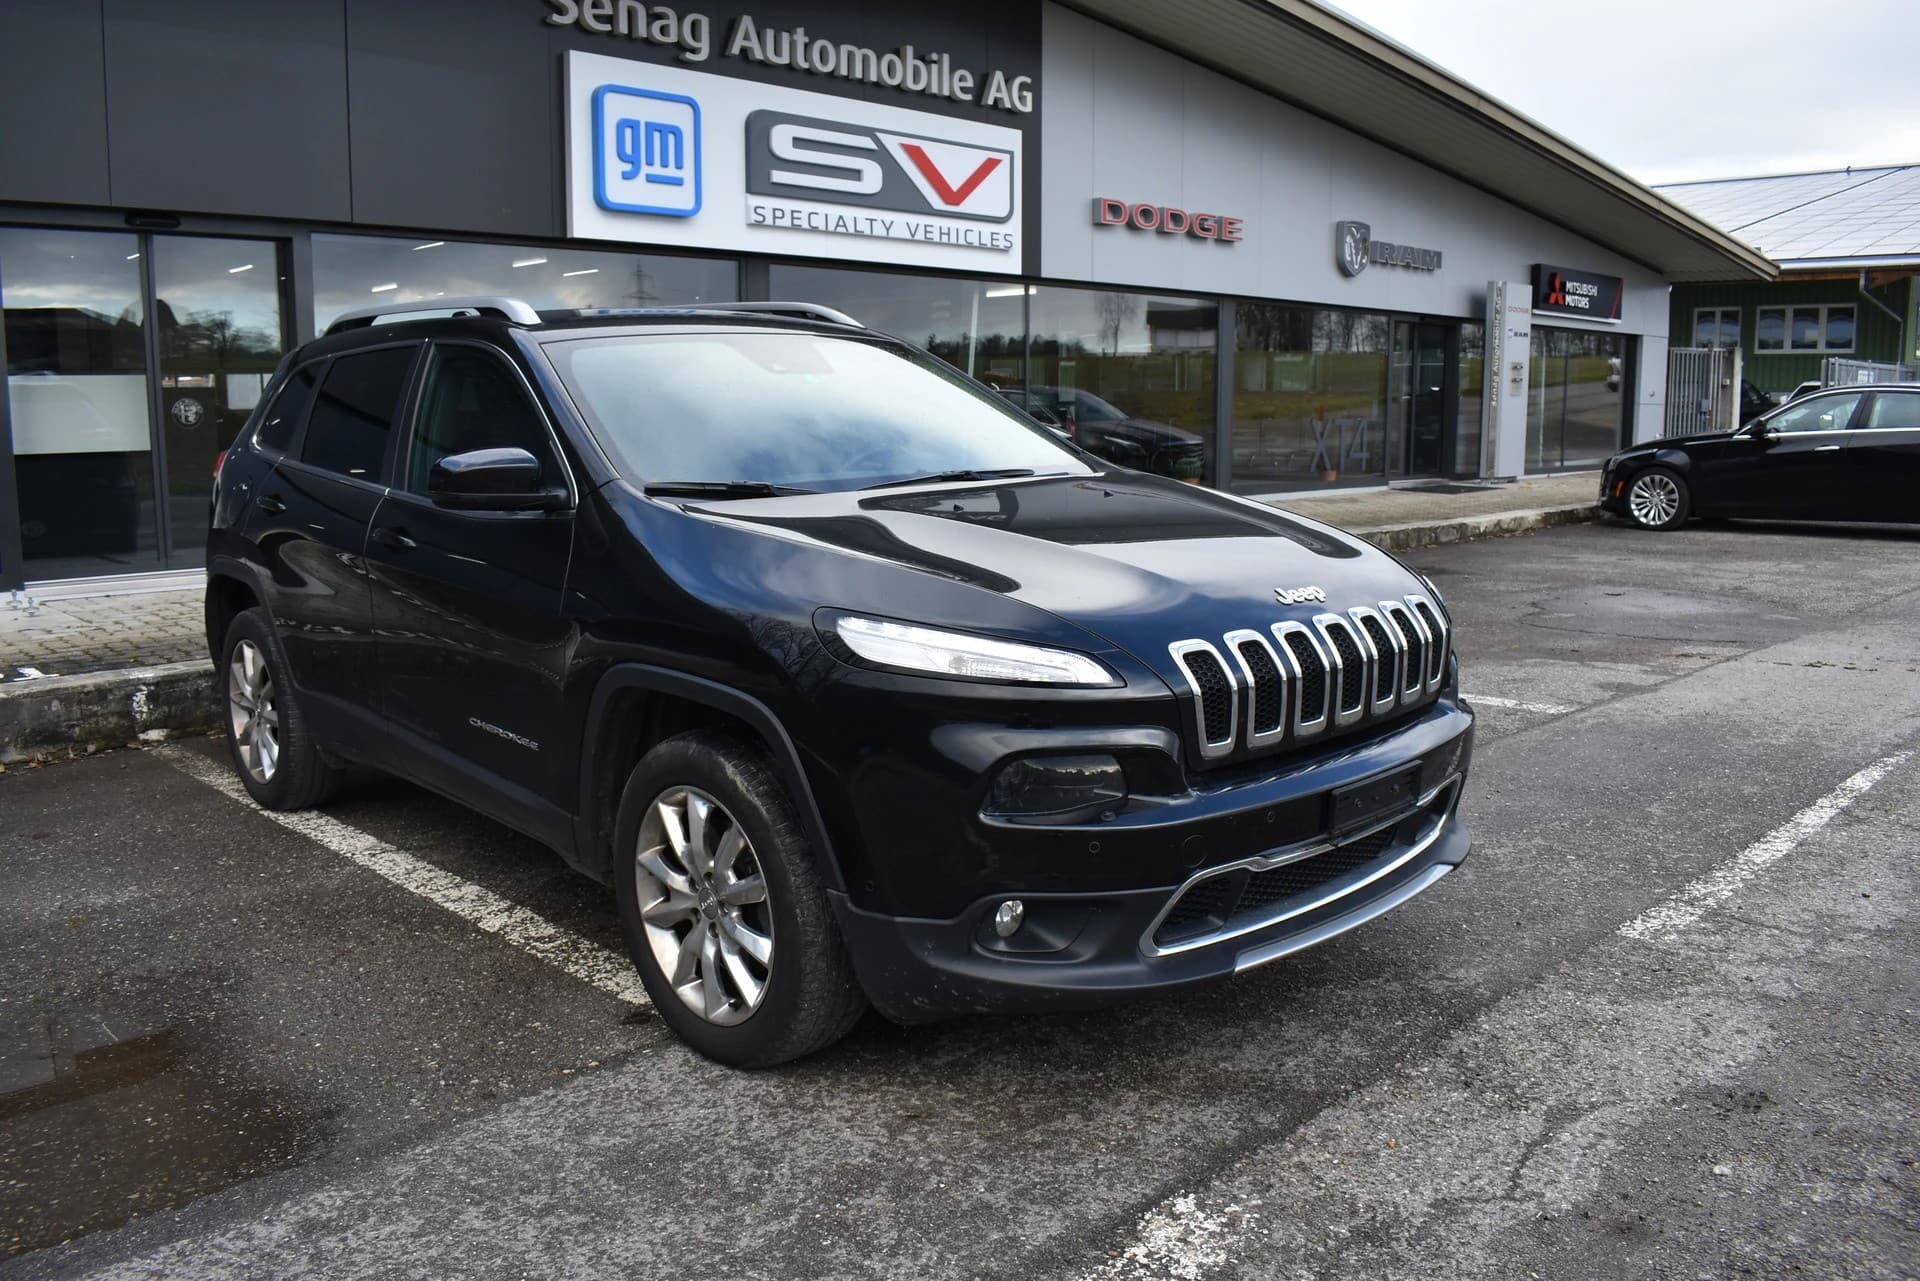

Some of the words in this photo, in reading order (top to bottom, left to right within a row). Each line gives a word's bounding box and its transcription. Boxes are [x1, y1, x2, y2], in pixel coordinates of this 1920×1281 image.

[725, 15, 975, 101] Automobile
[986, 70, 1033, 114] AG
[616, 117, 684, 186] gm
[768, 122, 1004, 207] SV
[753, 205, 895, 238] SPECIALTY
[906, 221, 1014, 250] VEHICLES
[1093, 198, 1244, 242] DODGE
[1370, 241, 1442, 271] RAM
[1565, 281, 1598, 297] MITSUBISHI
[1565, 294, 1590, 309] MOTORS
[1310, 417, 1369, 473] XT4
[1274, 585, 1327, 606] Jeep
[469, 717, 539, 752] CHEROKEE
